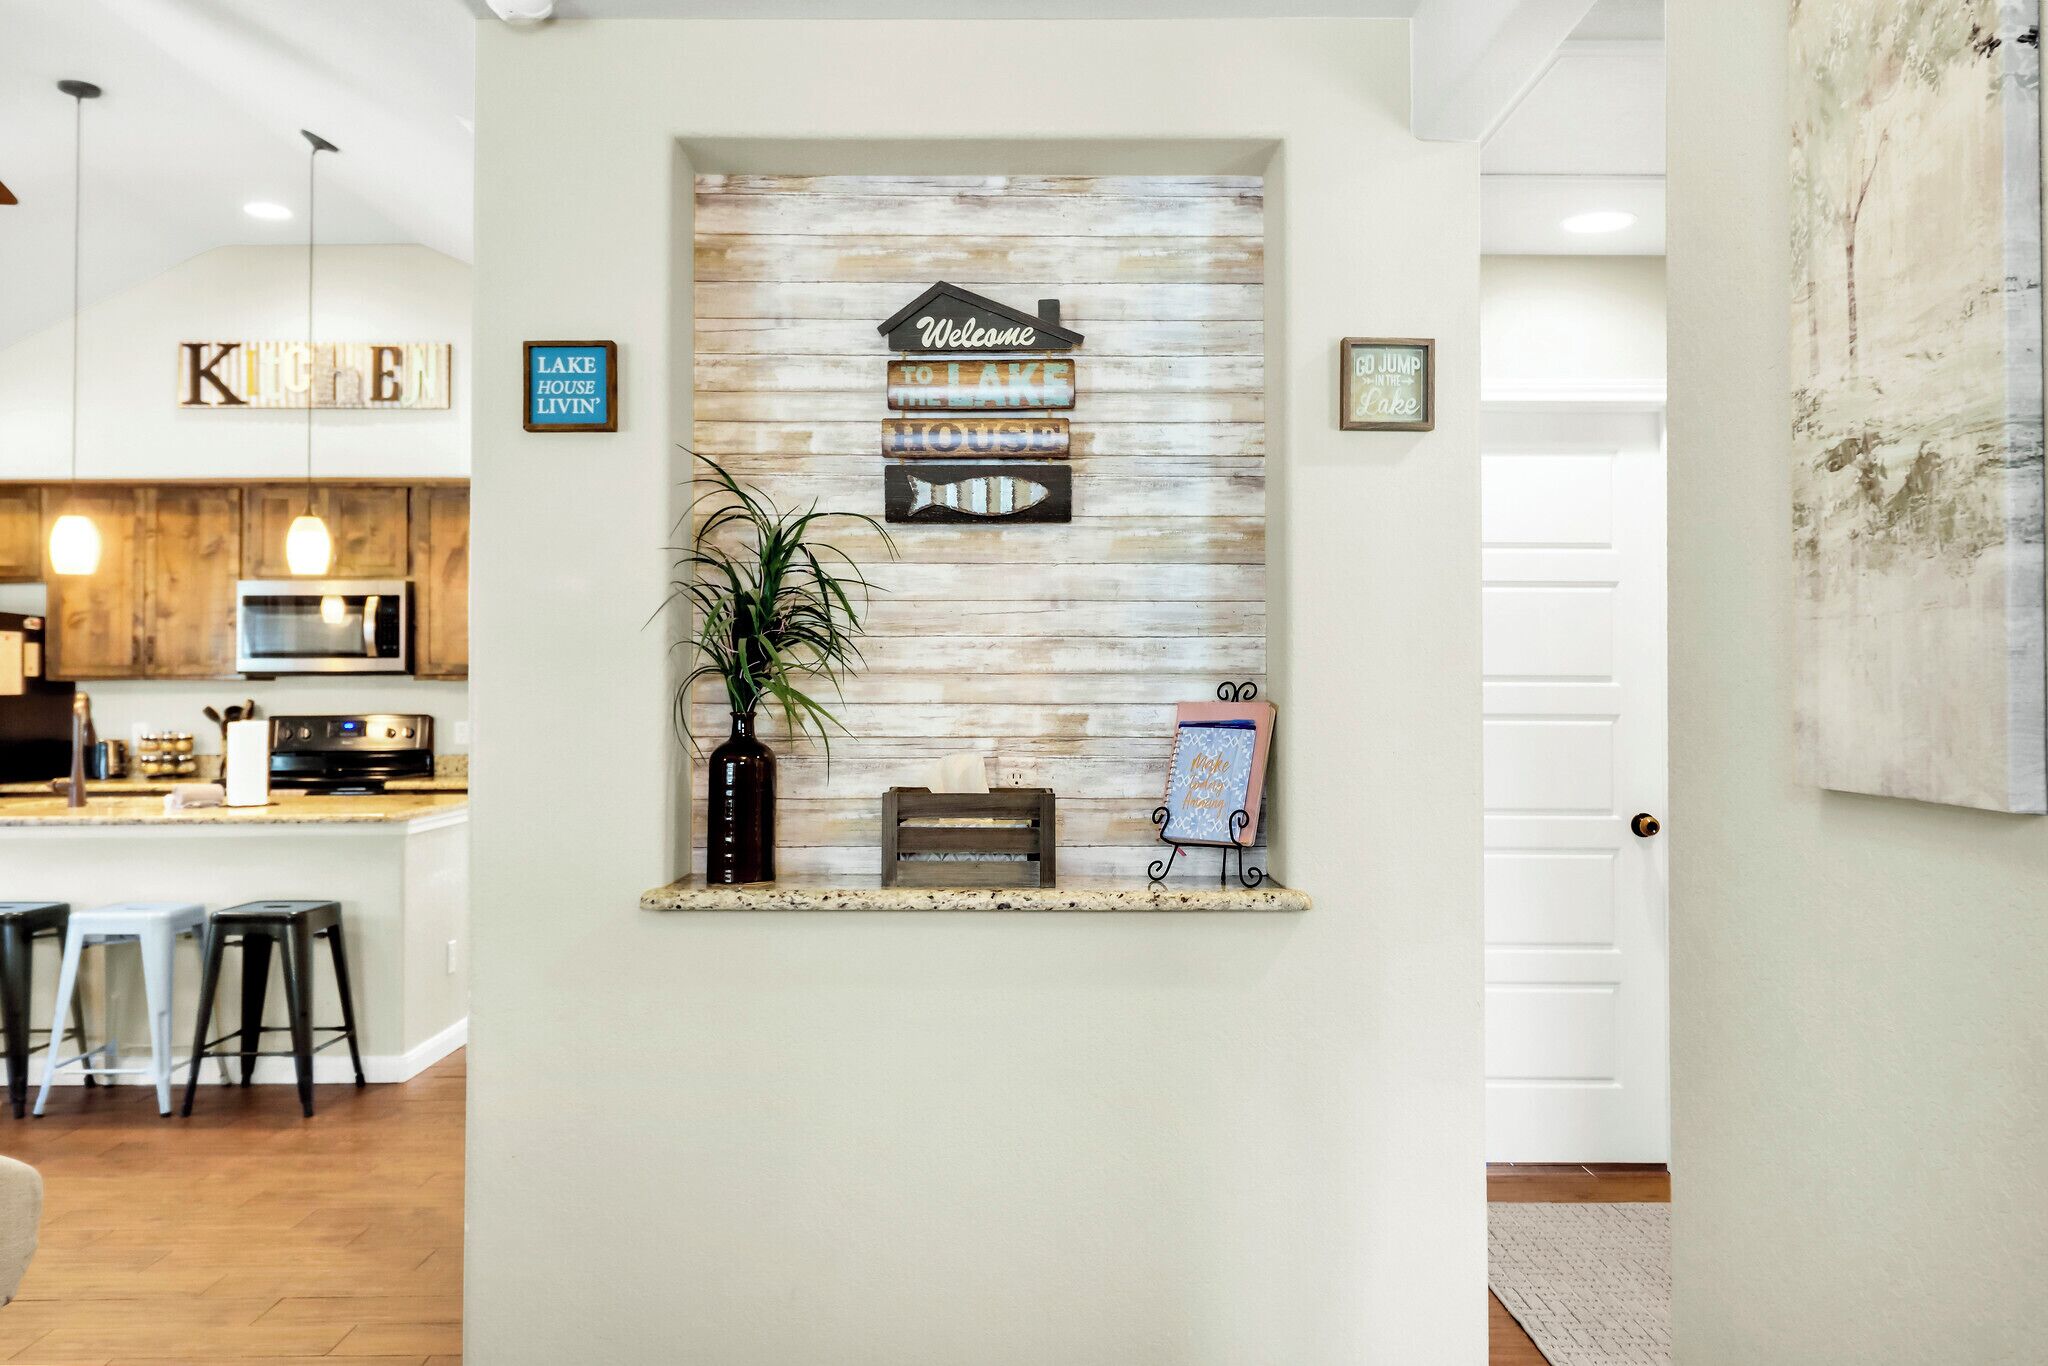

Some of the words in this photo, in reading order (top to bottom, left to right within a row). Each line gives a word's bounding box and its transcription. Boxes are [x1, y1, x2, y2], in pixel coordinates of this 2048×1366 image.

[916, 316, 1036, 349] Welcome
[537, 356, 597, 374] LAKE
[900, 366, 934, 385] TO
[1356, 354, 1375, 377] GO
[1378, 353, 1421, 376] JUMP
[537, 380, 597, 395] HOUSE
[947, 362, 1070, 407] LAKE
[1375, 375, 1385, 386] IN
[1386, 374, 1401, 387] THE
[537, 397, 601, 414] LIVIN'
[1356, 386, 1421, 417] Lake
[890, 422, 1061, 453] HOUSE
